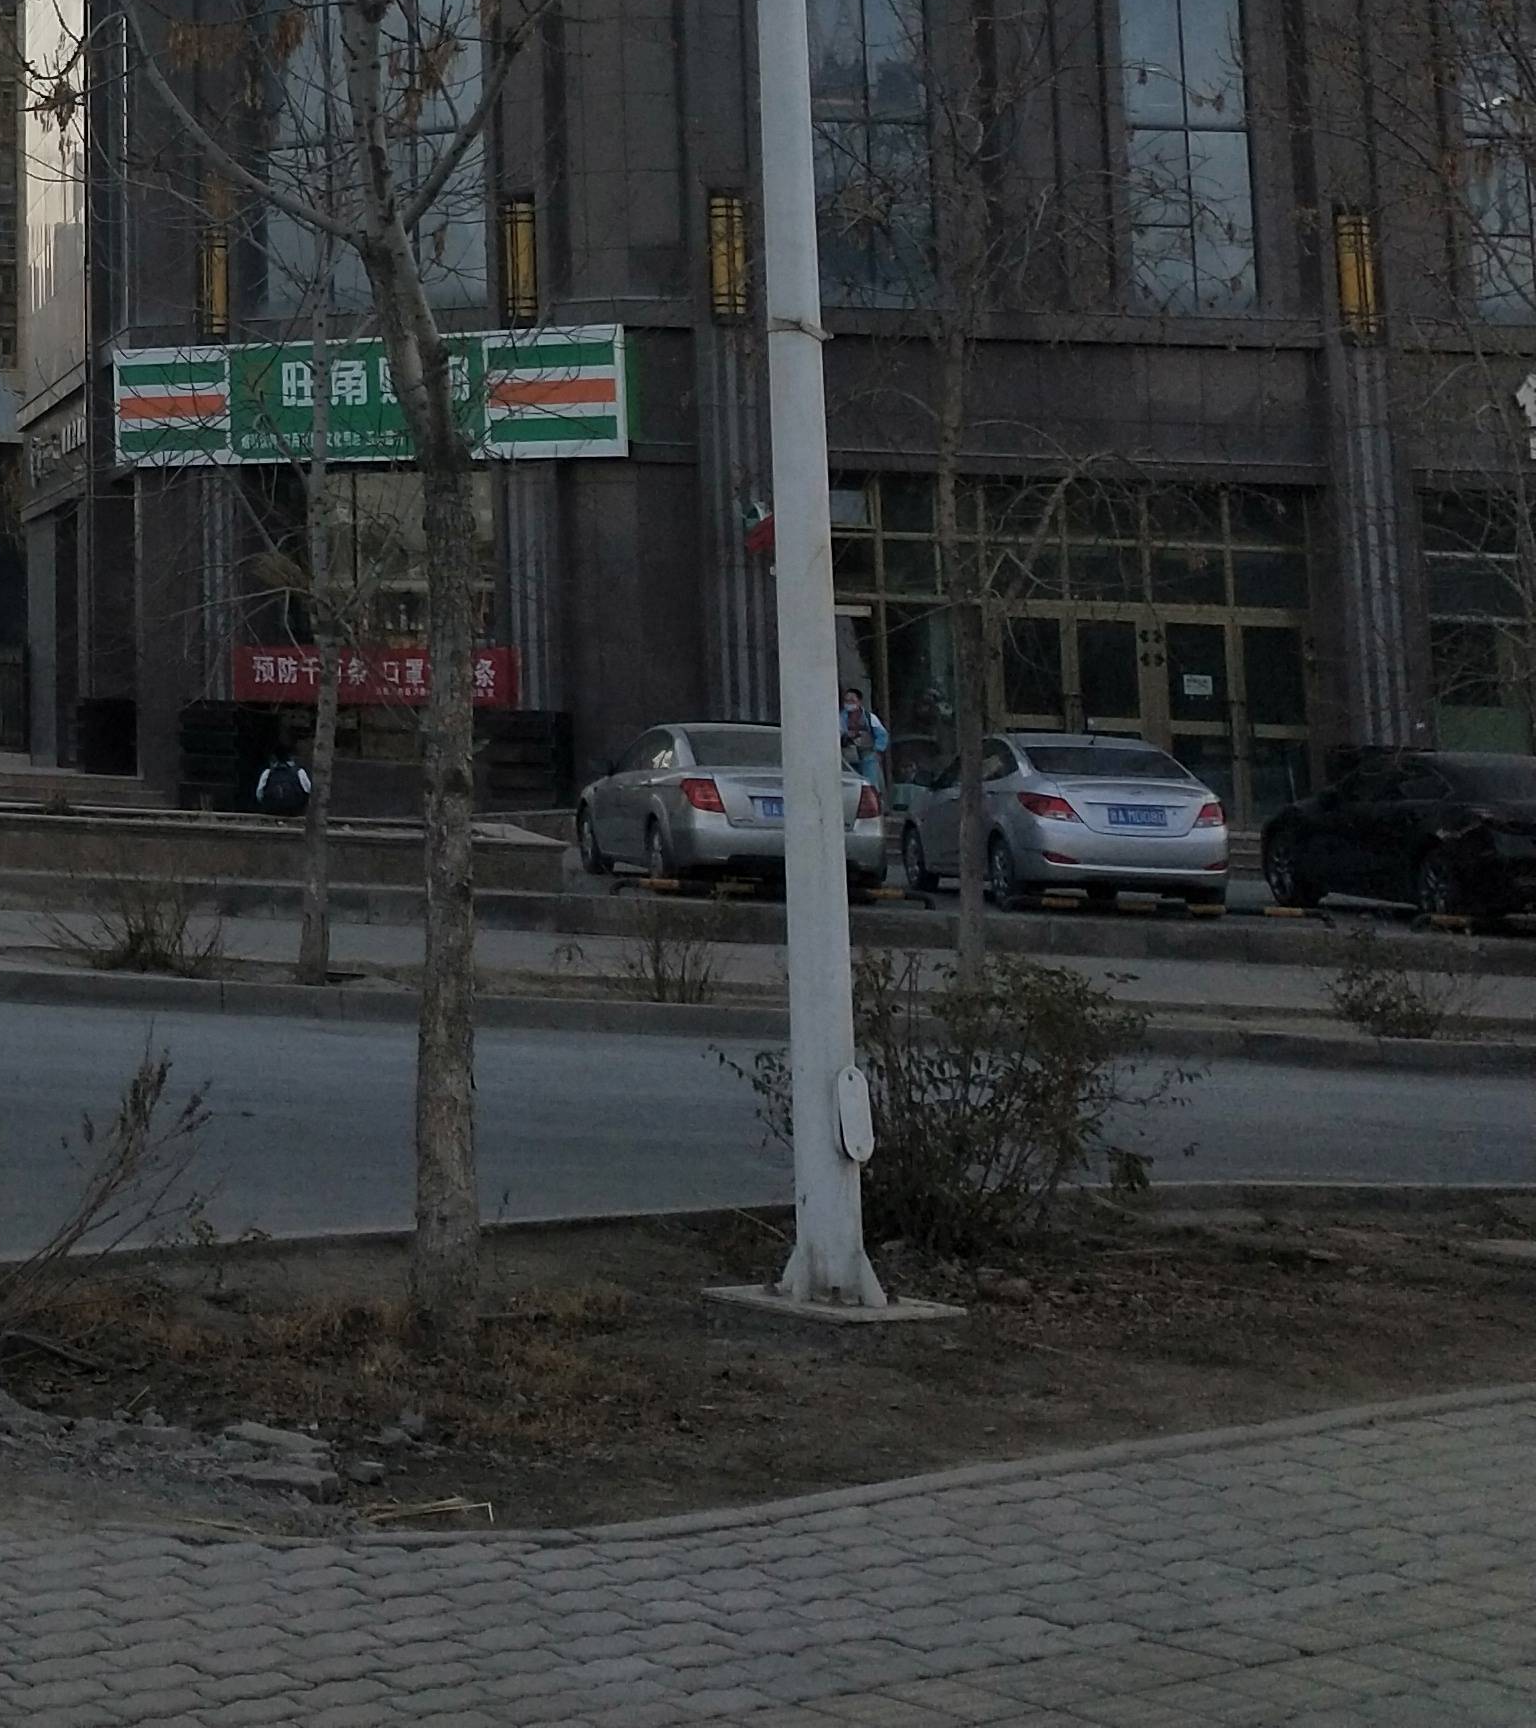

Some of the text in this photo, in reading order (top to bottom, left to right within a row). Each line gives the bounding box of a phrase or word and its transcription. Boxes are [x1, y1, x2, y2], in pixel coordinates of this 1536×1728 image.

[252, 655, 497, 688] 预防千条 口罩条
